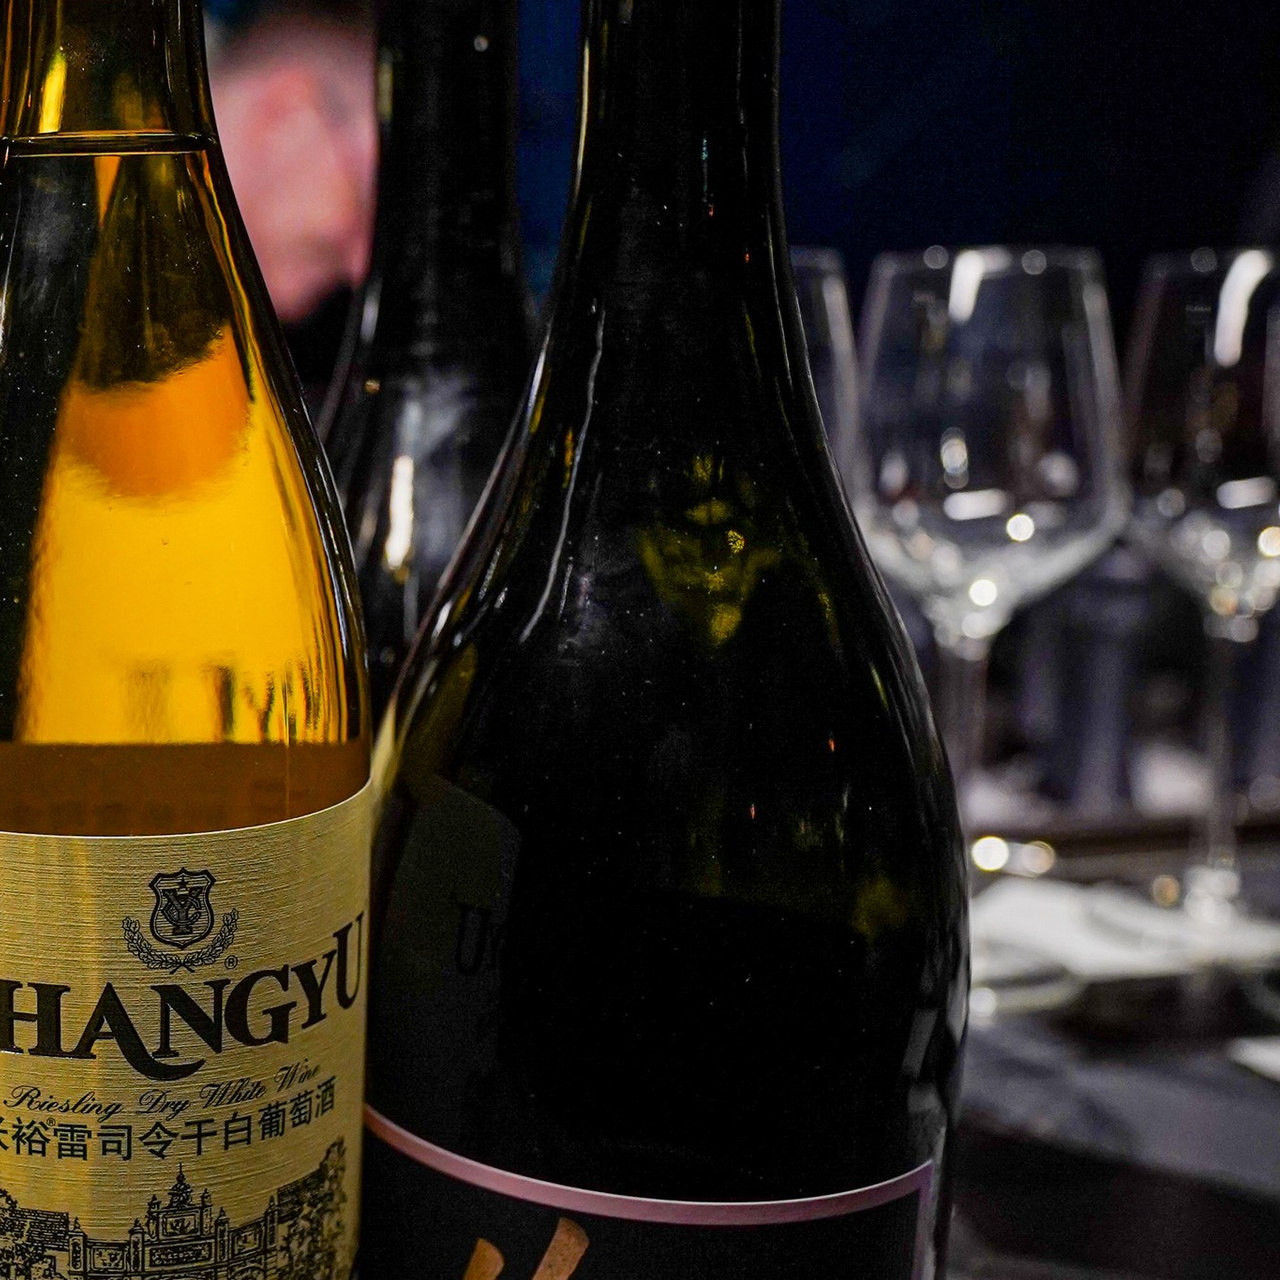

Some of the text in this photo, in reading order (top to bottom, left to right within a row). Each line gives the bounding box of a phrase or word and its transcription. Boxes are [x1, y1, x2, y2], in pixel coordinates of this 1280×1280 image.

[2, 1058, 320, 1123] Riesling Dry White Wine
